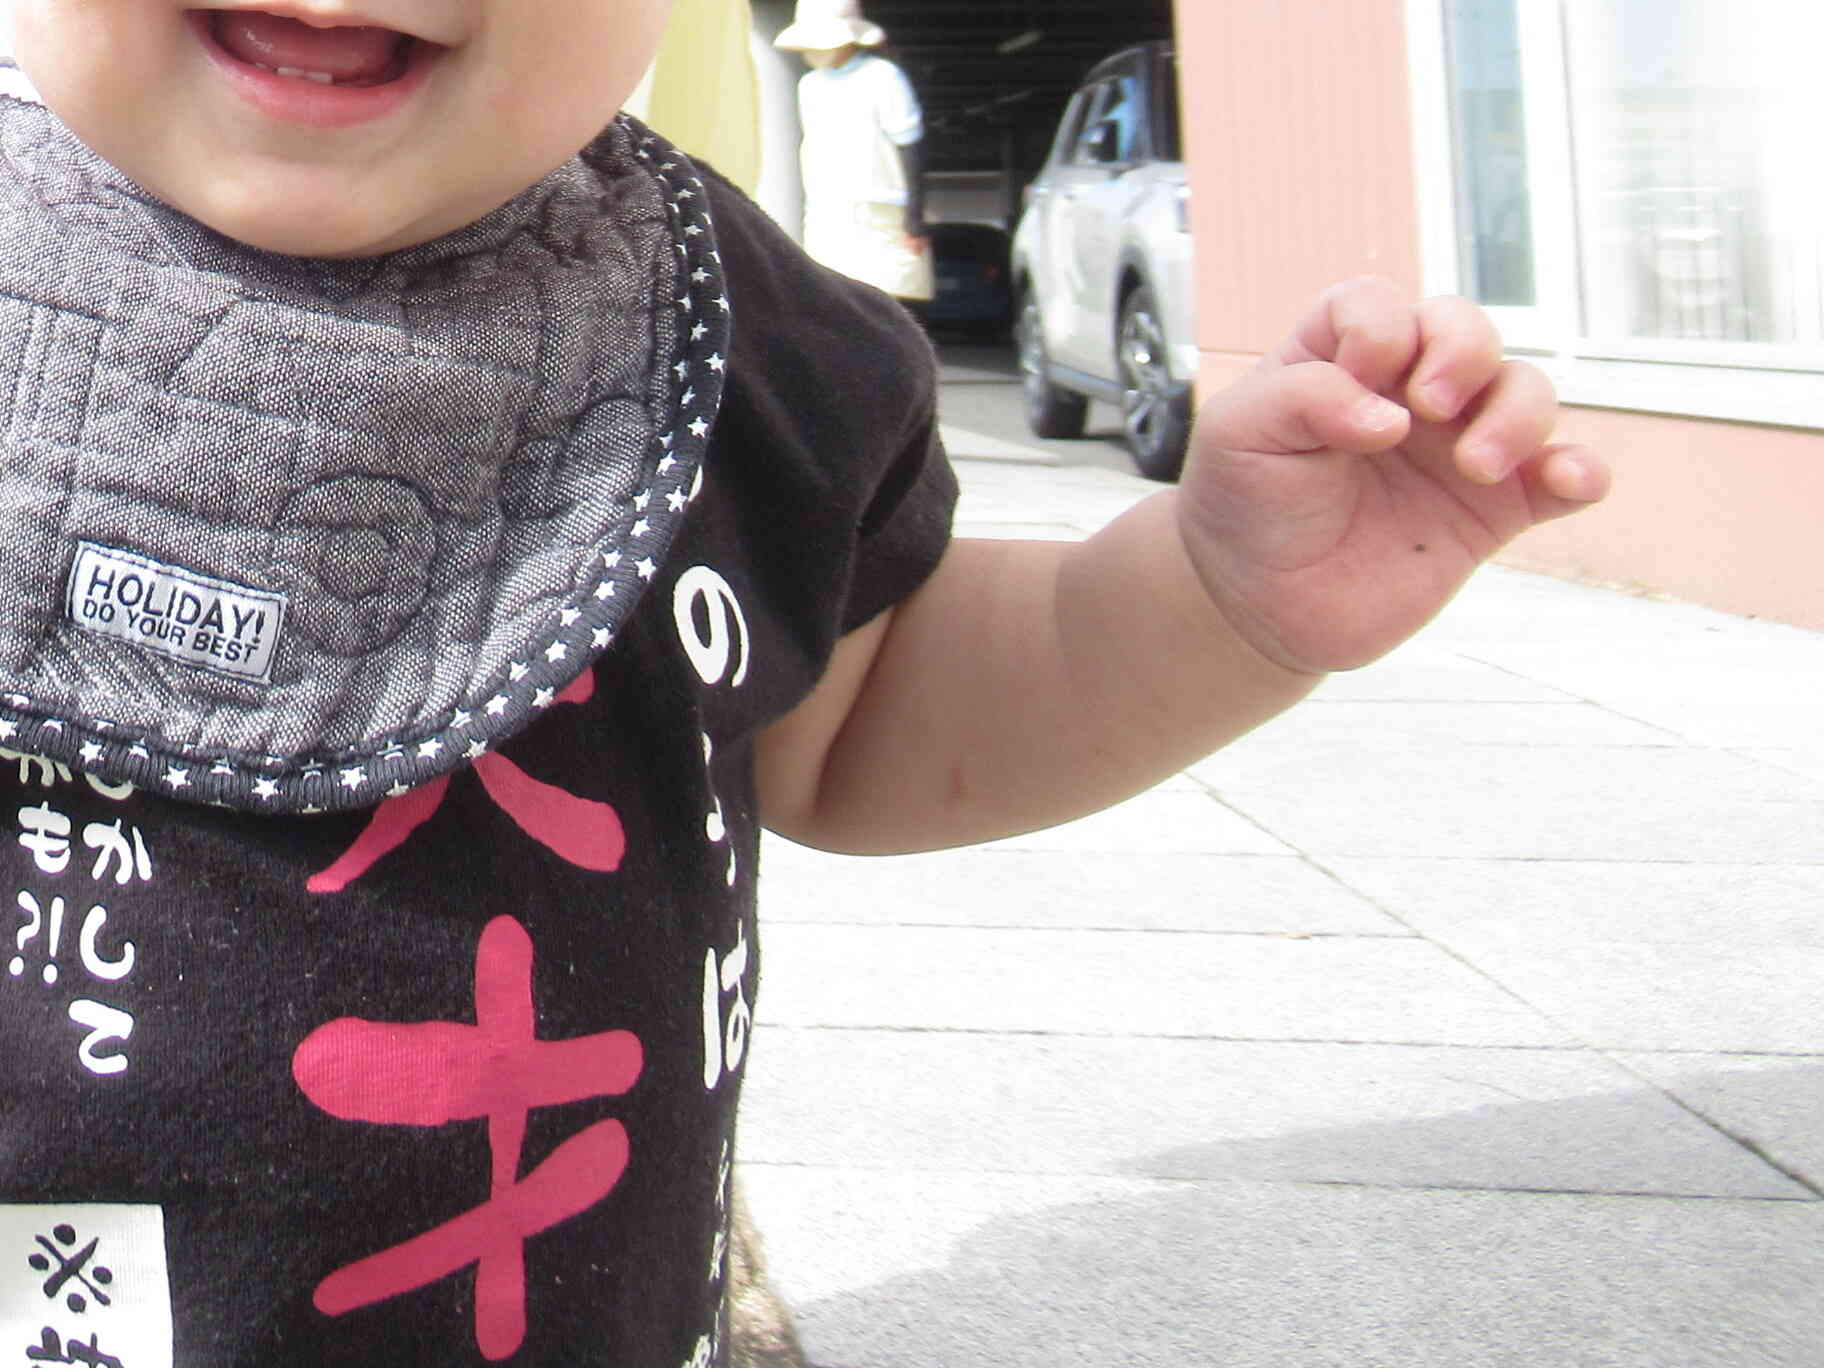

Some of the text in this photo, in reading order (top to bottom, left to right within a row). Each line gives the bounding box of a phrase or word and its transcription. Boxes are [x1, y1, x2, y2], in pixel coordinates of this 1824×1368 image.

[82, 598, 259, 664] DO YOUR BEST
[87, 564, 266, 643] HOLIDAY!
